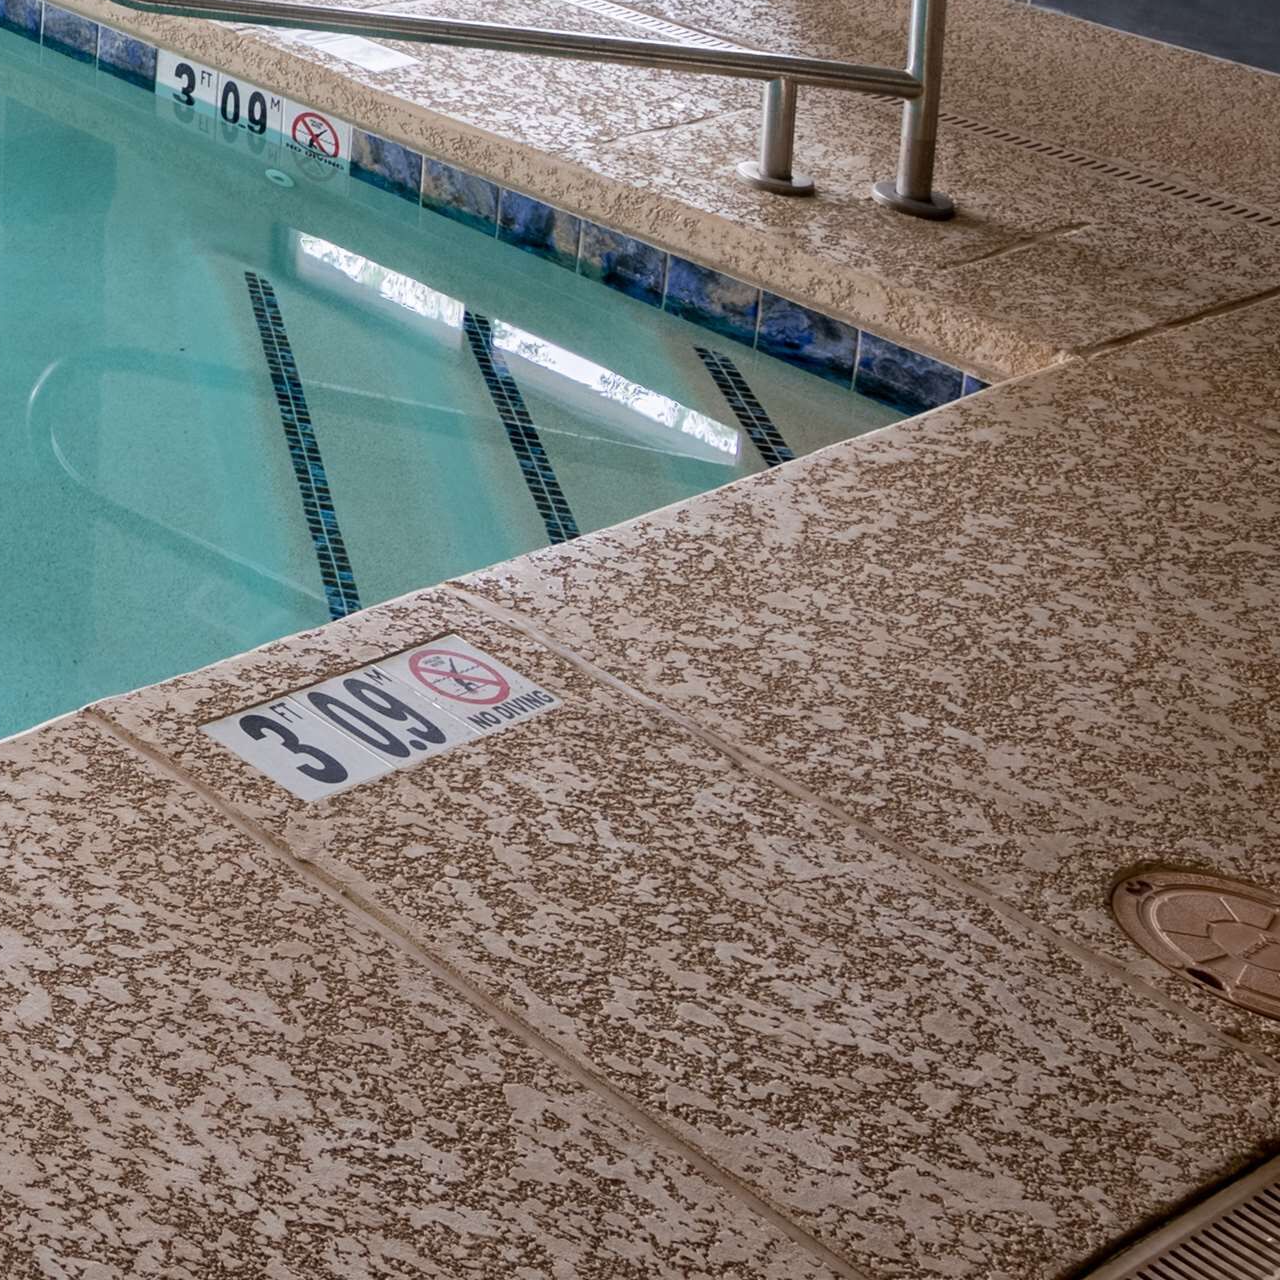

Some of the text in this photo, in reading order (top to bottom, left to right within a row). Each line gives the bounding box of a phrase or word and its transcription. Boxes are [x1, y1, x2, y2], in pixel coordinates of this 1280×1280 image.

[173, 63, 196, 106] 3
[201, 70, 213, 88] FT
[271, 97, 280, 113] M
[239, 670, 447, 784] 3 FT 0.9 M
[467, 690, 555, 730] NO DIVING
